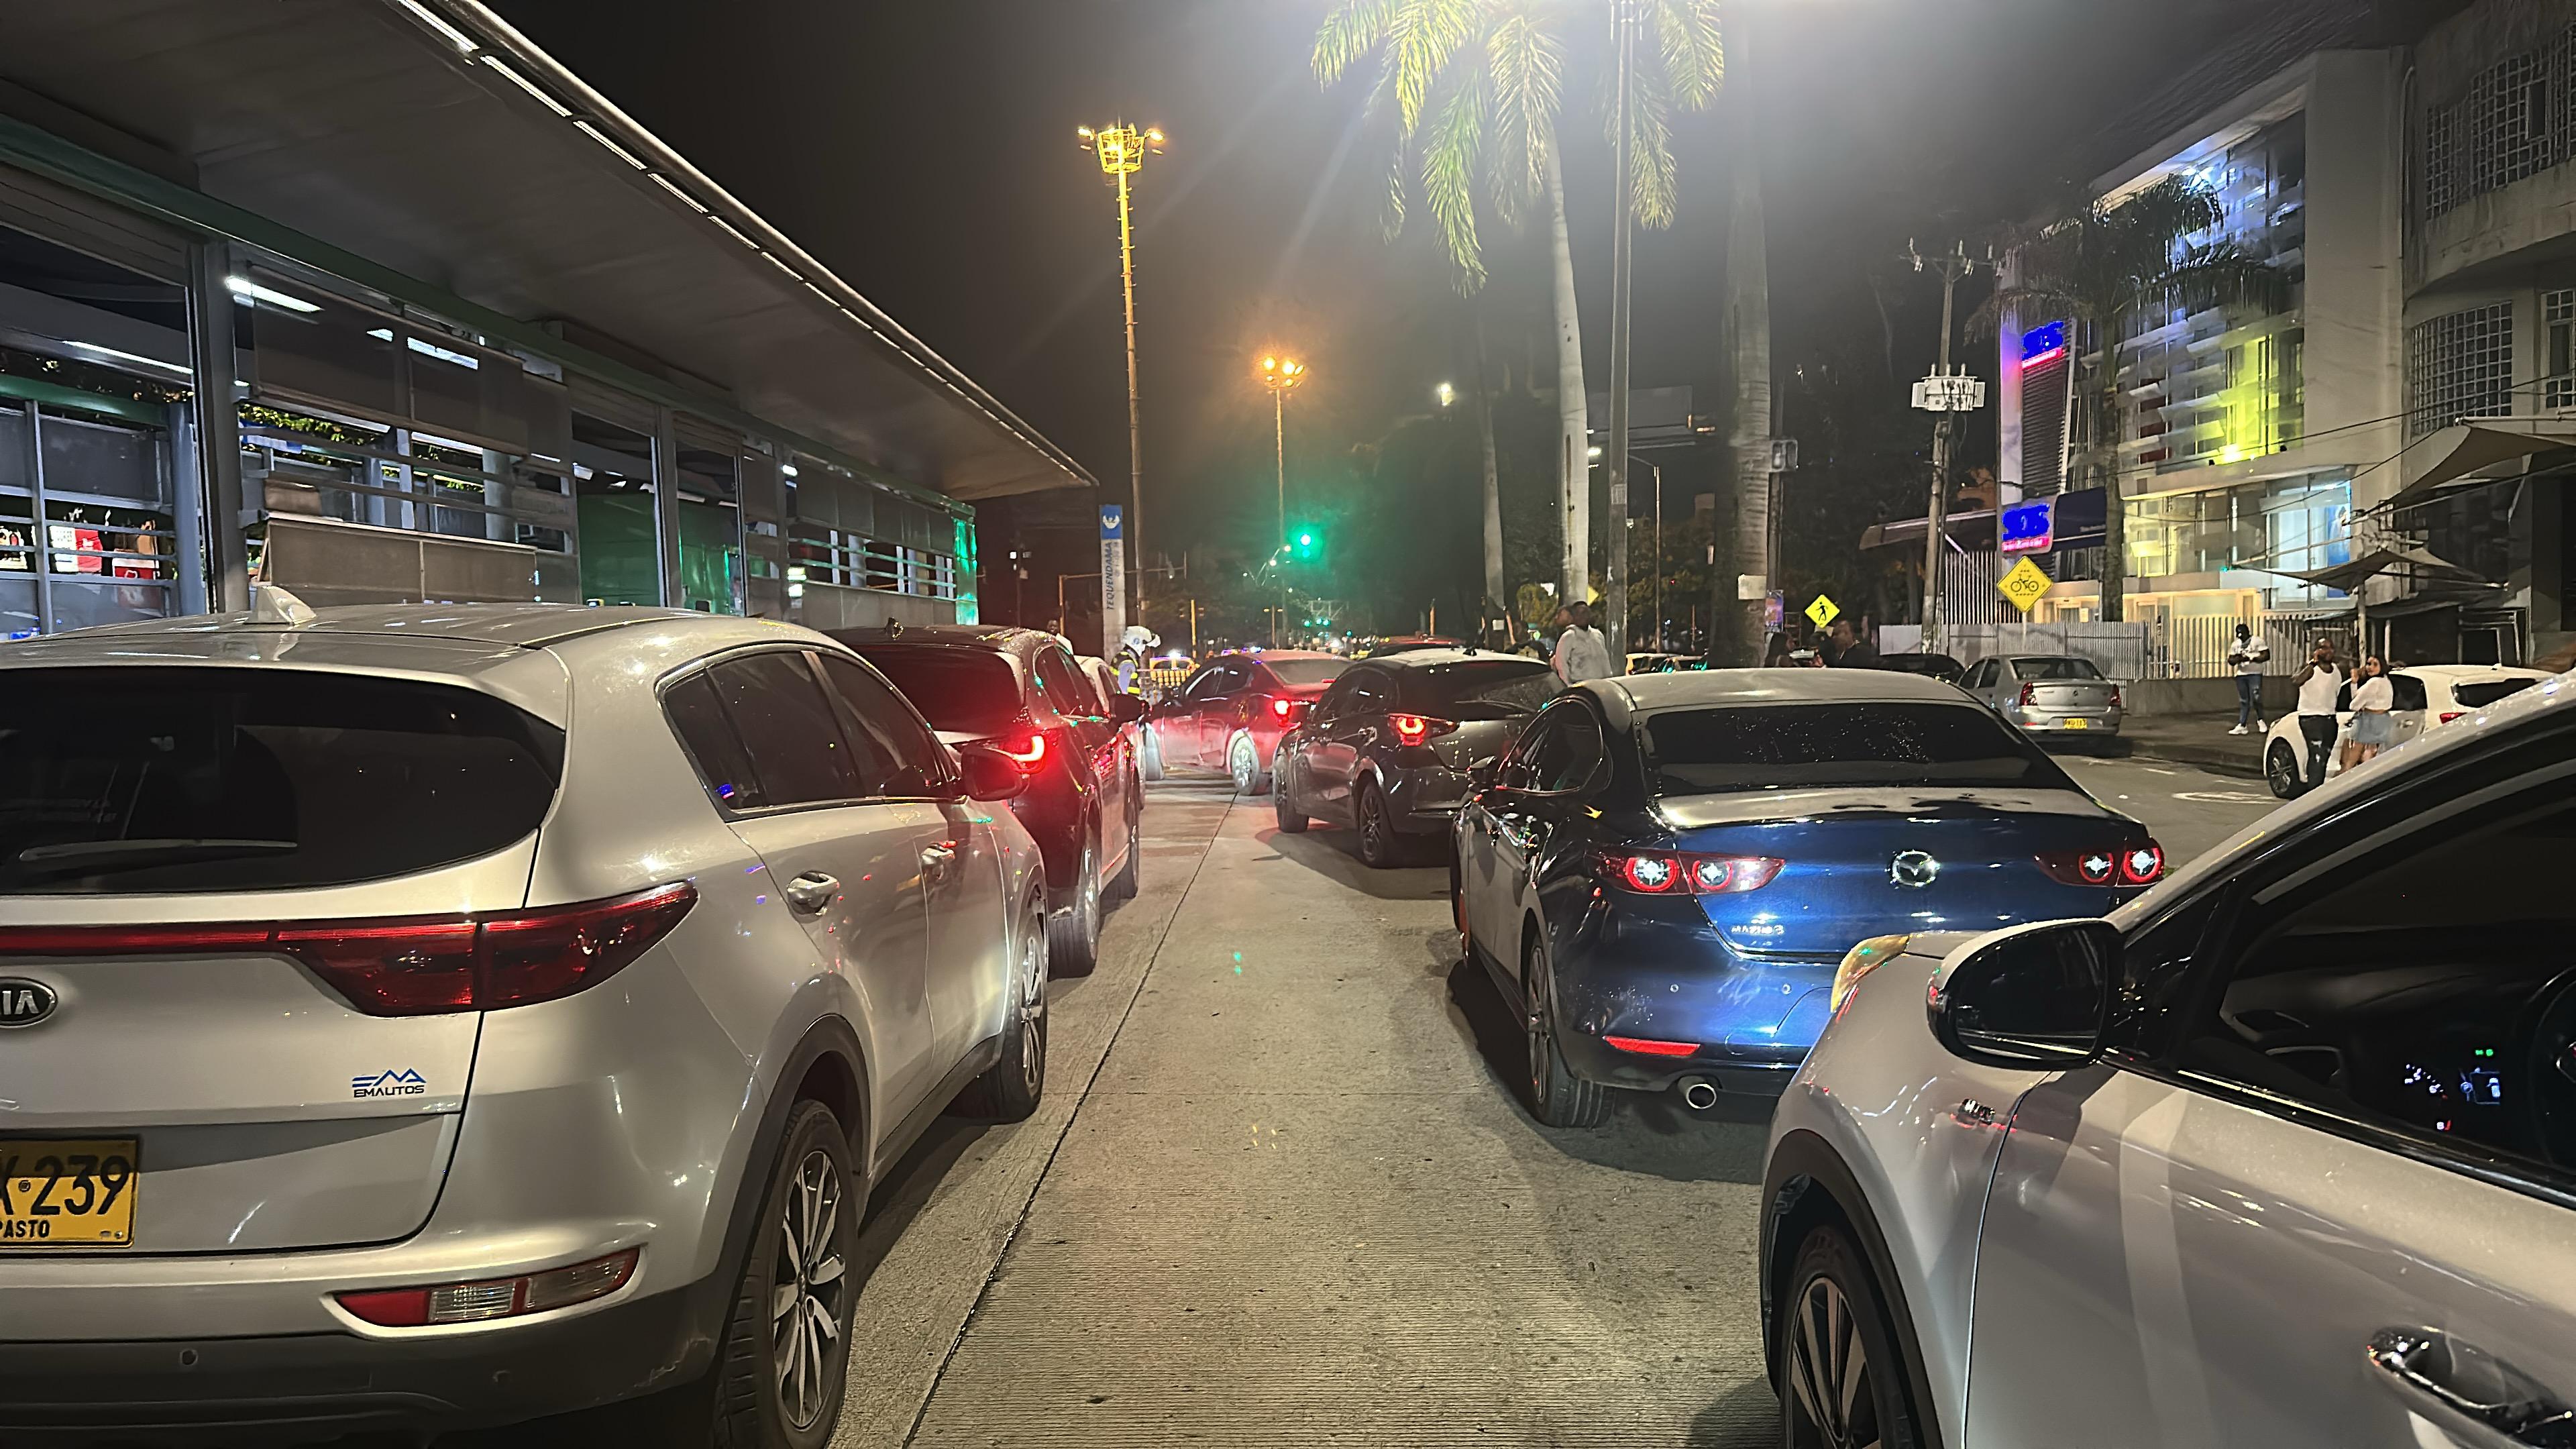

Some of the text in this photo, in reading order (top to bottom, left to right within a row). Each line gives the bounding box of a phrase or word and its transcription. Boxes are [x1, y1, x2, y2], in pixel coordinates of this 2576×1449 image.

[1105, 541, 1115, 610] TEQUENDAMA
[0, 990, 40, 1015] IA
[354, 1085, 424, 1097] EMAUTOS
[0, 1220, 50, 1238] ASTO
